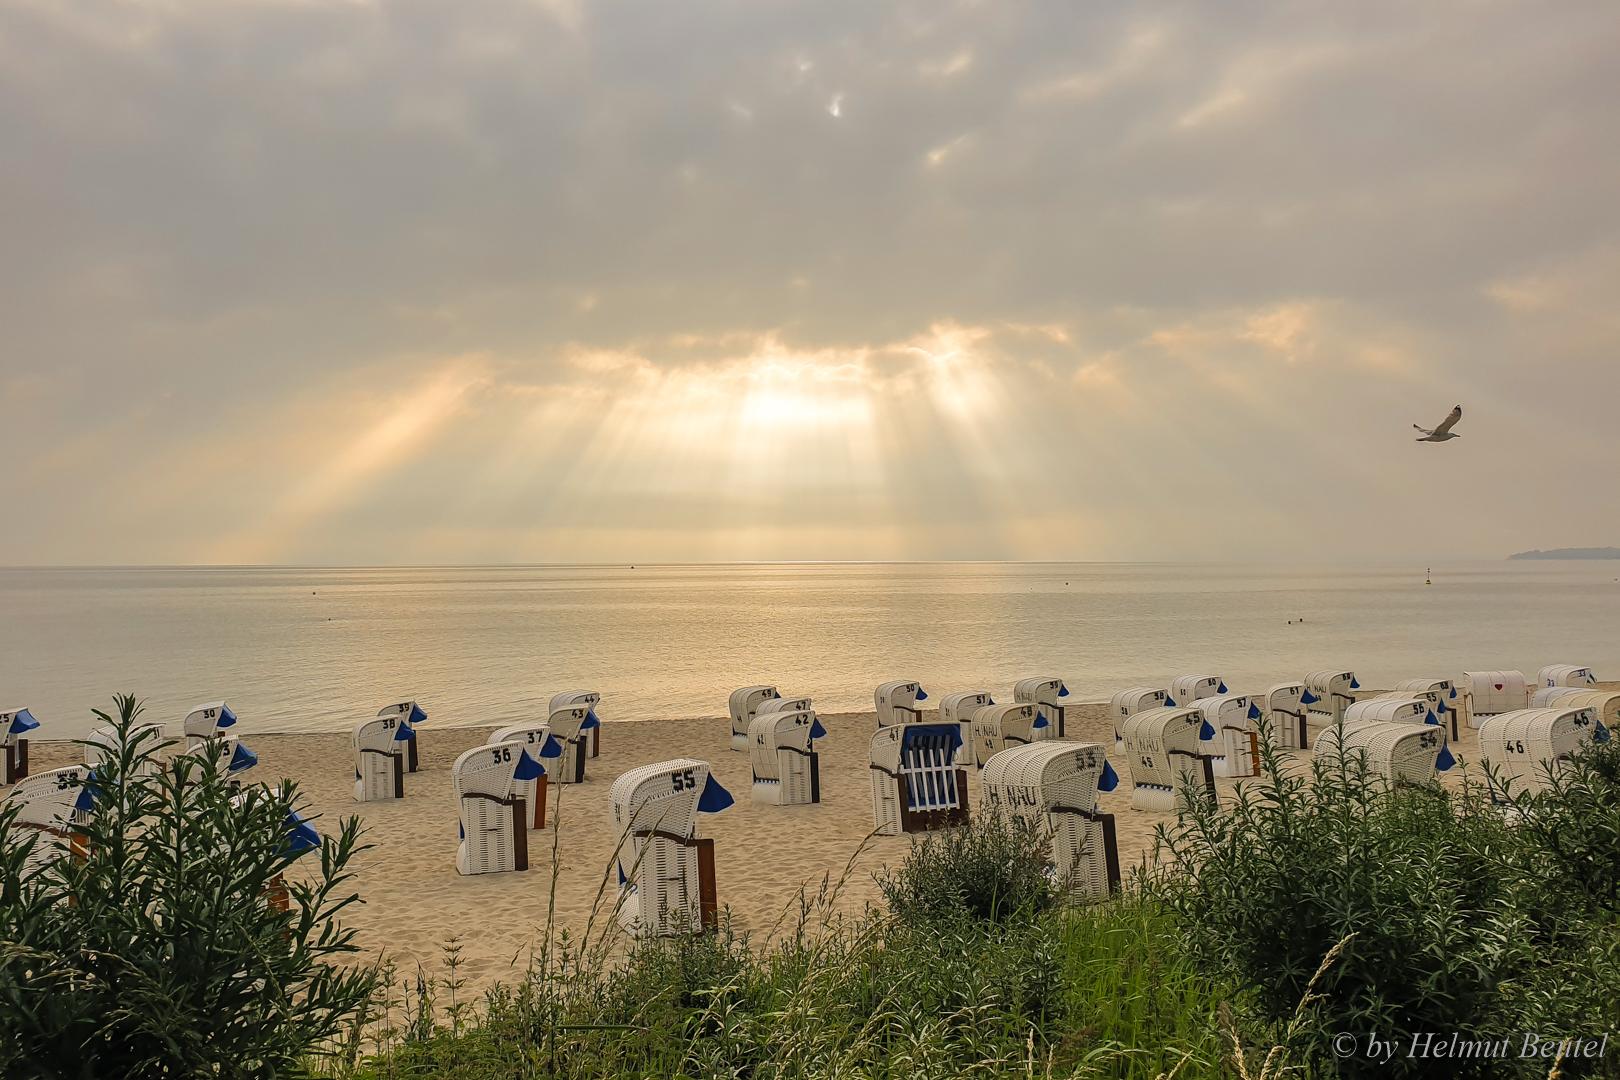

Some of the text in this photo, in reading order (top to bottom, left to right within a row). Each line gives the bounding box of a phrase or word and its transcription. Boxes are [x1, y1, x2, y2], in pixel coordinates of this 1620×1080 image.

[1578, 669, 1587, 678] 33
[1547, 678, 1555, 687] 33
[761, 689, 772, 698] 49
[906, 684, 915, 693] 50
[1290, 686, 1299, 696] 61
[976, 695, 986, 704] 51
[1154, 691, 1164, 701] 58
[399, 702, 410, 713] 39
[796, 701, 806, 711] 47
[1237, 698, 1247, 708] 57
[203, 709, 216, 719] 30
[571, 708, 584, 719] 43
[1413, 703, 1425, 715] 56
[382, 719, 396, 729] 38
[795, 714, 809, 725] 42
[1186, 711, 1200, 726] 45
[1573, 712, 1590, 728] 46
[889, 727, 899, 741] 41
[983, 725, 998, 738] NAU
[527, 731, 543, 744] 37
[1138, 738, 1159, 752] NAU
[1506, 740, 1525, 754] 46
[492, 748, 512, 764] 36
[1141, 755, 1154, 768] 45
[671, 768, 696, 792] 55
[1007, 785, 1036, 806] NAU
